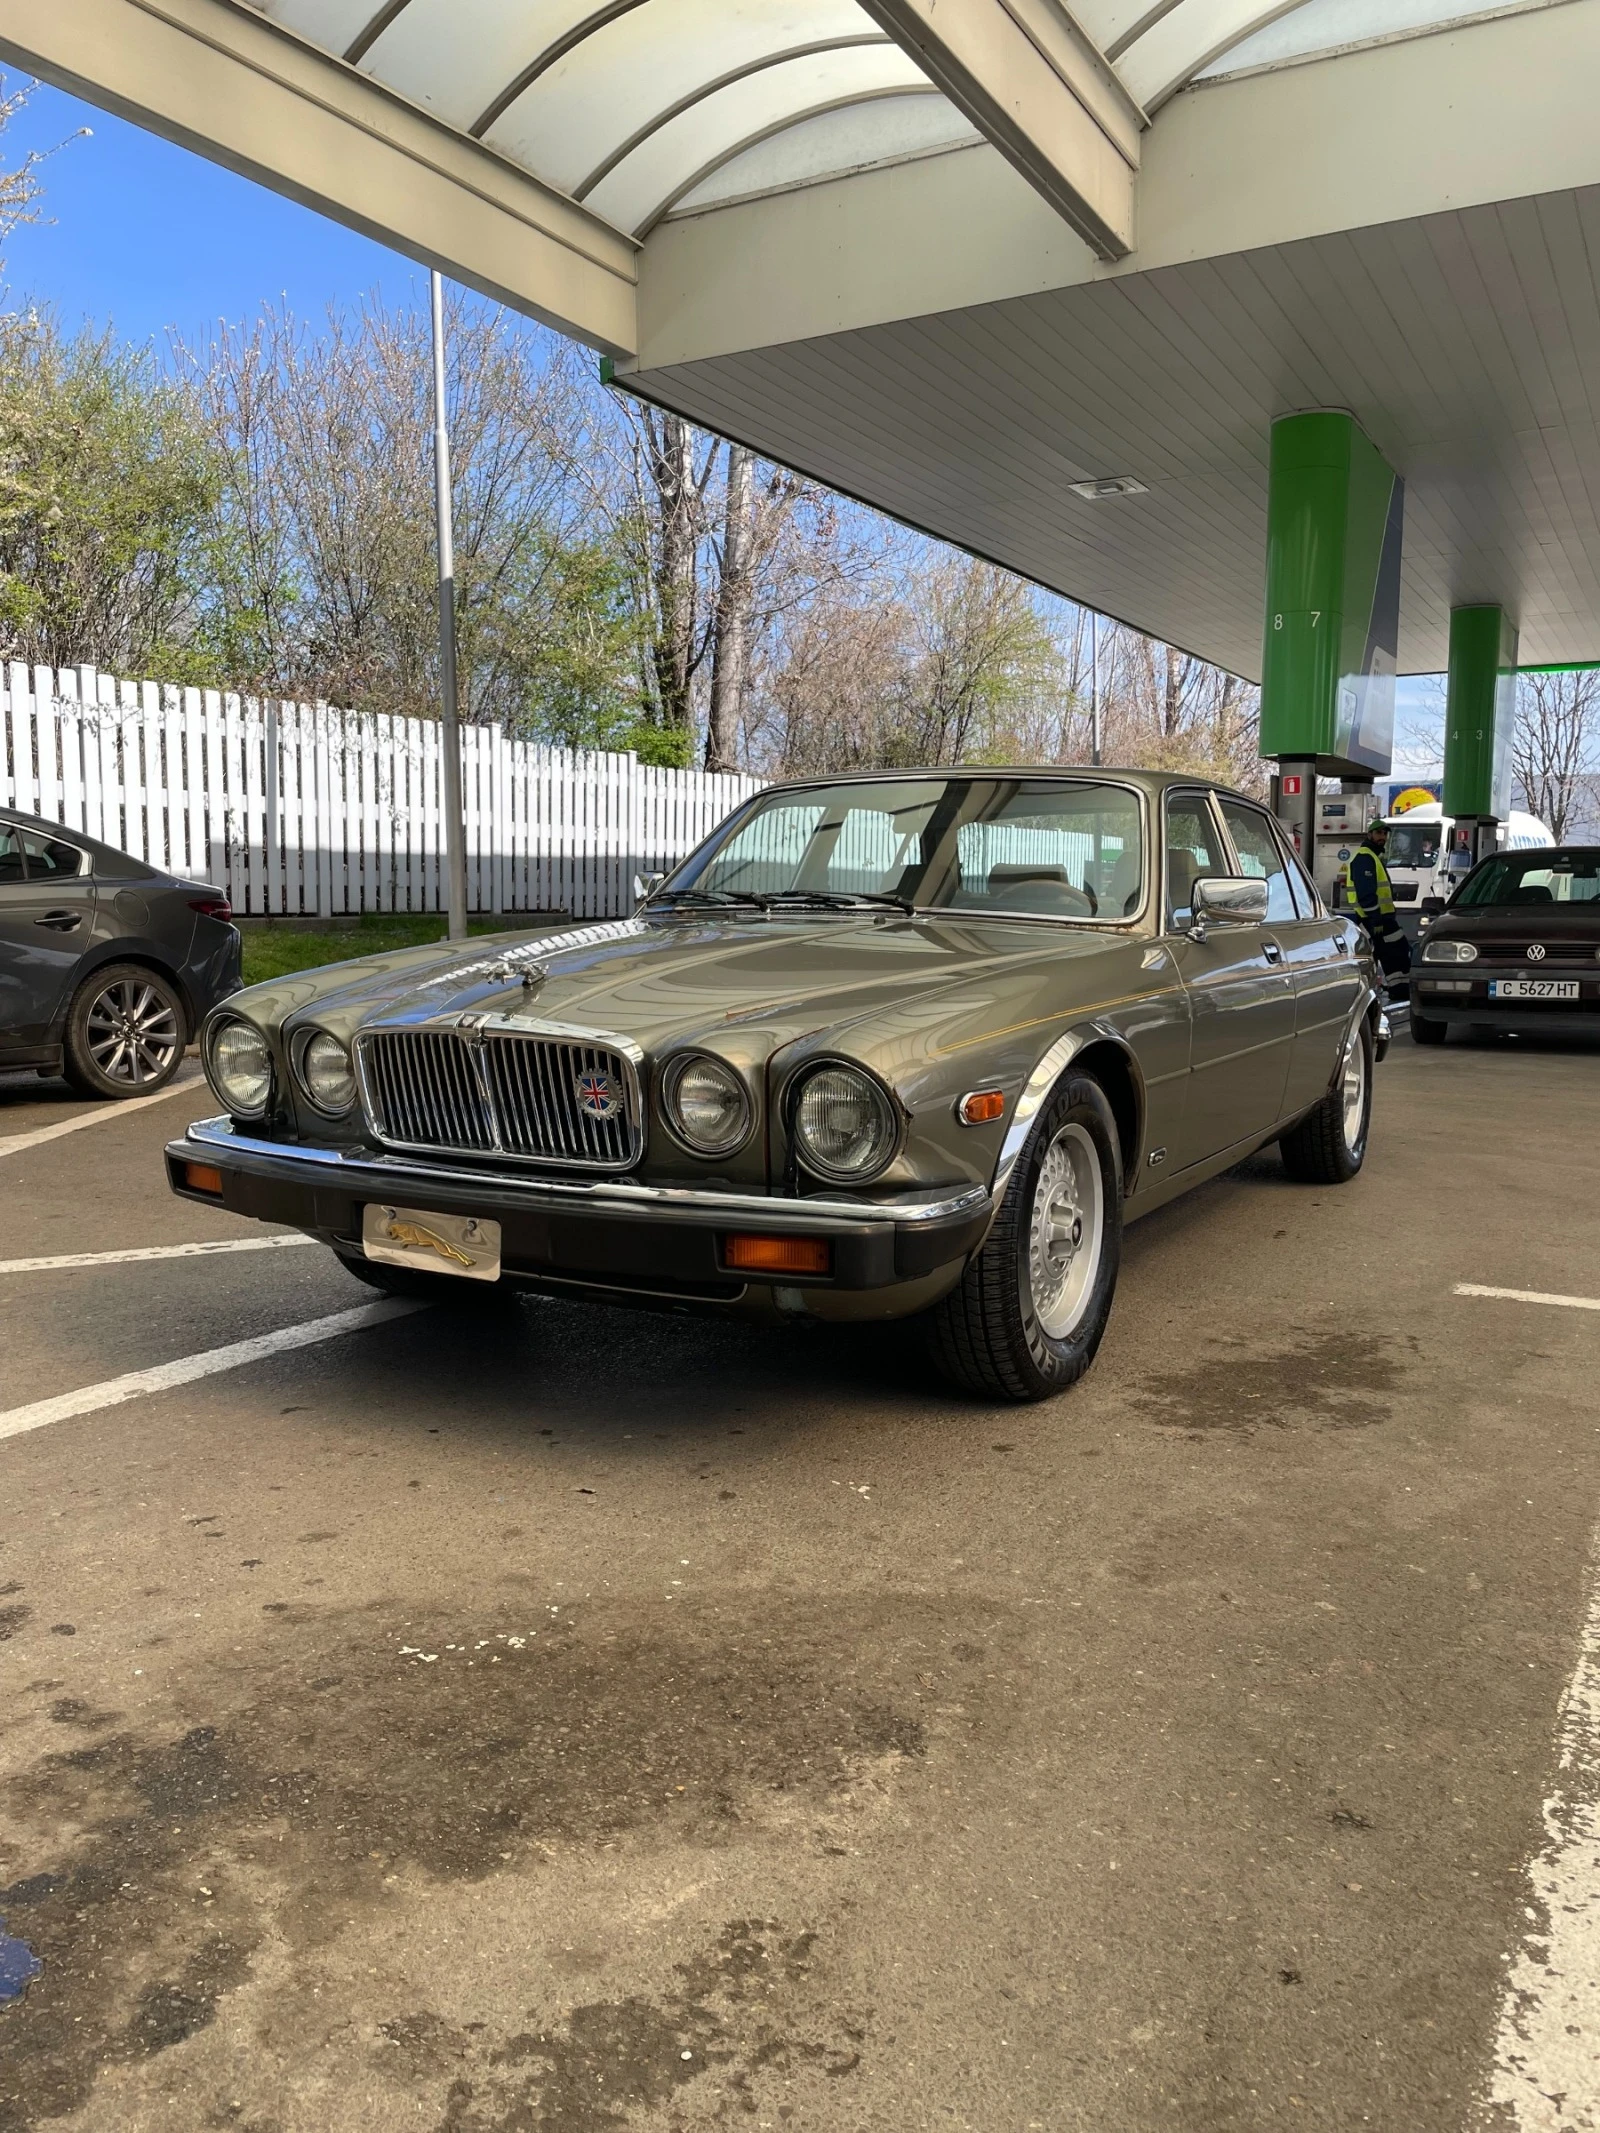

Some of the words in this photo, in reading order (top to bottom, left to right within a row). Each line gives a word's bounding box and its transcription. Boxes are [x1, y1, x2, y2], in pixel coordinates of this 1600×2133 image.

[1274, 613, 1283, 631] 8
[1310, 611, 1321, 628] 7
[1452, 730, 1459, 741] 4
[1475, 729, 1483, 740] 3
[1503, 982, 1512, 995] C
[1519, 980, 1555, 996] 5627
[1556, 983, 1577, 997] HT
